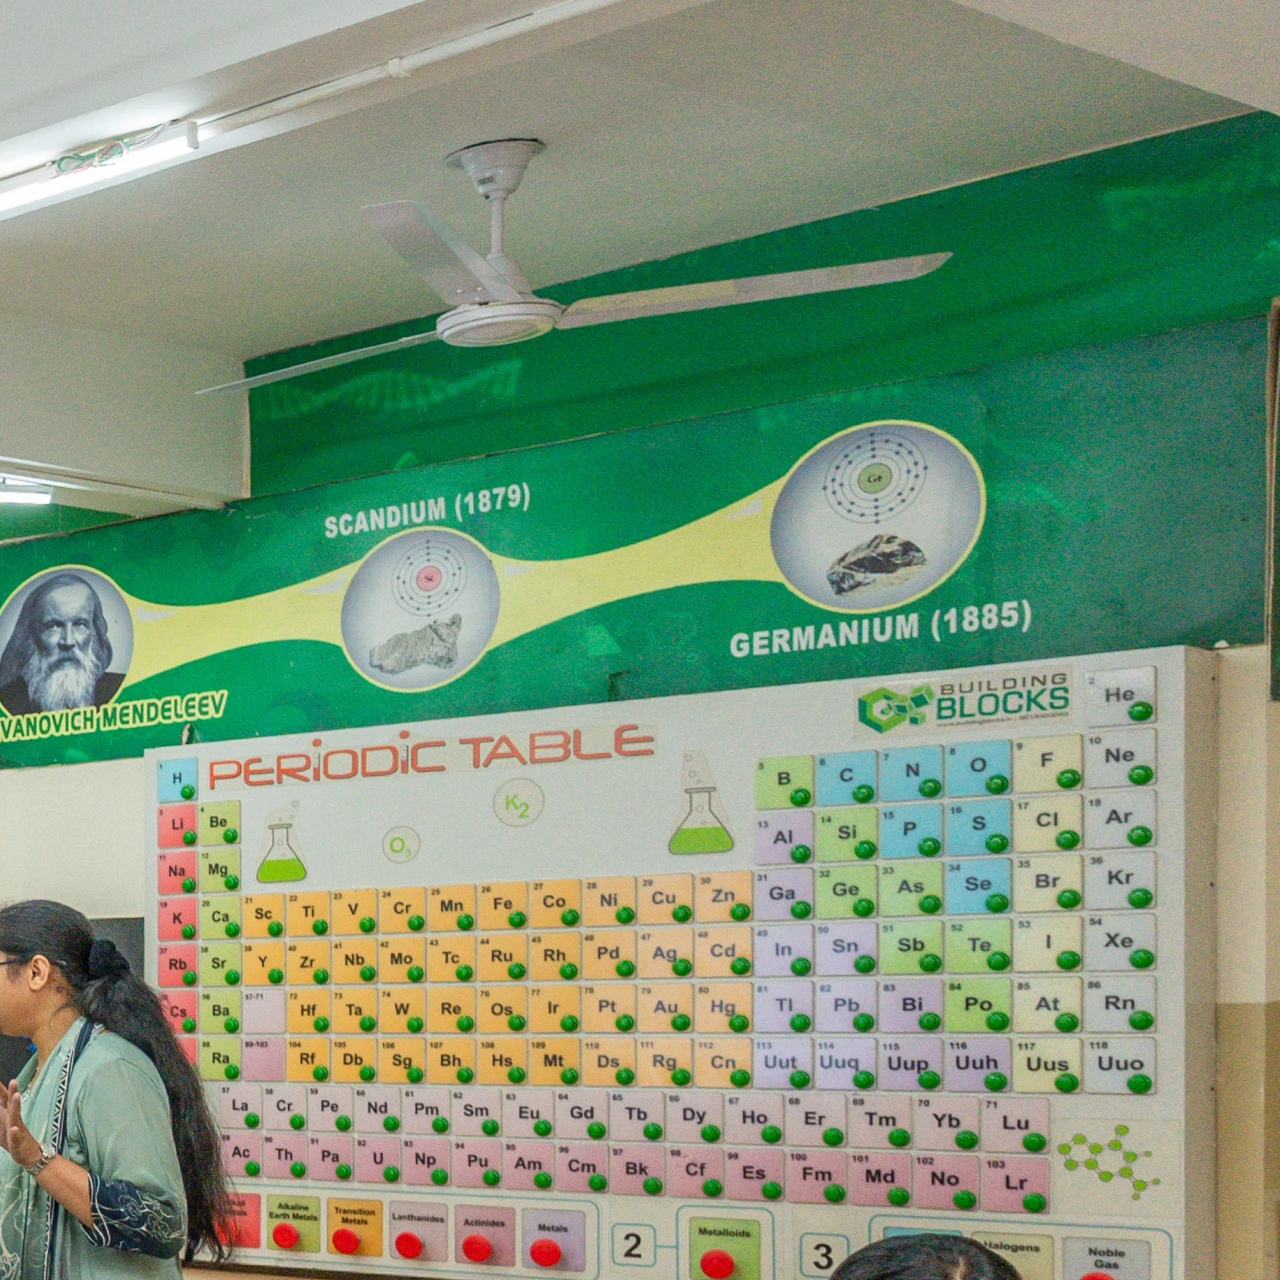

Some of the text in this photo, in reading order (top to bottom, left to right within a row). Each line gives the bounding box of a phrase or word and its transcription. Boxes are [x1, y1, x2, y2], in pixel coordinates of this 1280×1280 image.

[324, 482, 530, 539] SCANDIUM (1879)
[730, 600, 1033, 658] GERMANIUM (1885)
[941, 673, 1068, 695] BUILDING
[1105, 687, 1136, 703] He
[100, 689, 228, 731] MENDELEEV
[936, 686, 1070, 721] BLOCKS
[459, 724, 654, 768] TABLE
[1040, 751, 1054, 768] F
[1105, 747, 1135, 764] Ne
[905, 762, 920, 778] N
[969, 756, 988, 773] O
[172, 772, 183, 785] H
[777, 771, 792, 786] B
[839, 767, 854, 783] C
[171, 817, 184, 831] Li
[209, 815, 228, 828] Be
[972, 815, 987, 831] S
[1036, 811, 1059, 828] Cl
[1105, 809, 1133, 825] Ar
[773, 829, 793, 845] Al
[837, 824, 857, 840] Si
[903, 821, 917, 837] P
[168, 864, 186, 877] Na
[208, 864, 229, 879] Mg
[493, 896, 513, 911] Fe
[651, 890, 677, 905] Cu
[172, 912, 183, 925] K
[1097, 1055, 1145, 1072] Uuo
[277, 1202, 310, 1212] Alkaline
[334, 1206, 376, 1217] Transition
[268, 1211, 319, 1222] Earth Metals
[341, 1216, 369, 1226] Metals
[391, 1212, 445, 1224] Lanthanides
[463, 1218, 506, 1228] Actinides
[537, 1223, 569, 1233] Metals
[698, 1227, 752, 1239] Metalloids
[623, 1232, 642, 1259] 2
[1088, 1247, 1126, 1258] Noble
[813, 1243, 834, 1270] 3
[1093, 1259, 1120, 1270] Gas
